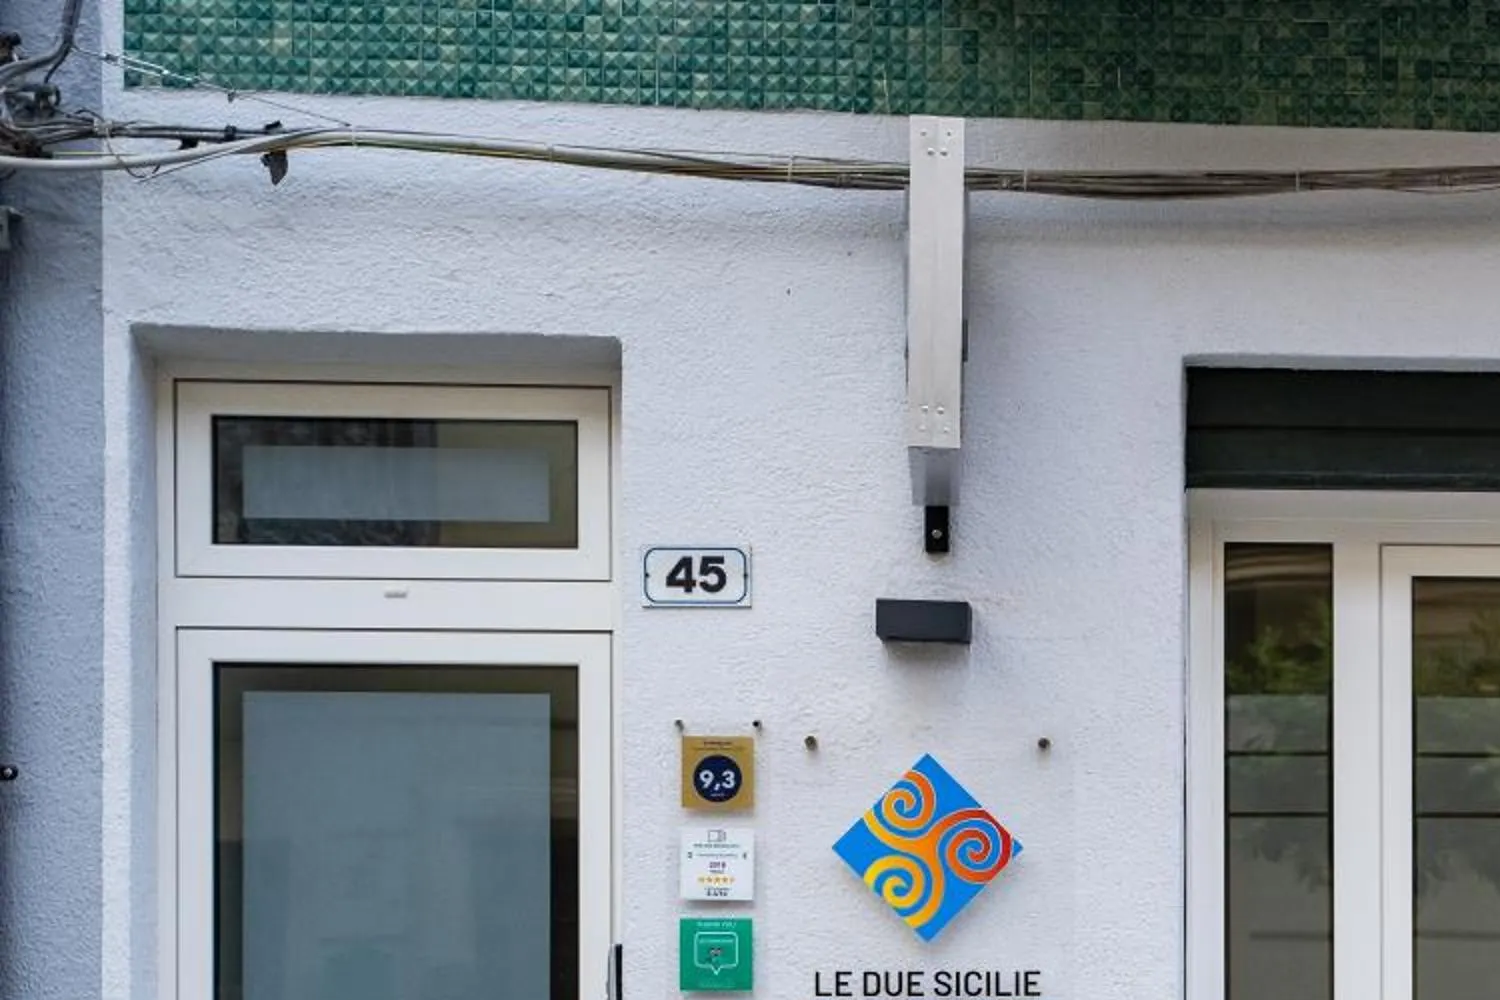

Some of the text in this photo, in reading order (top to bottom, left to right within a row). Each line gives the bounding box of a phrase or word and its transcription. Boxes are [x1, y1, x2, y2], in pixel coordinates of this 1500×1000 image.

[665, 556, 726, 593] 45
[700, 769, 735, 791] 9,3
[815, 971, 1041, 997] LE DUE SICILIE
